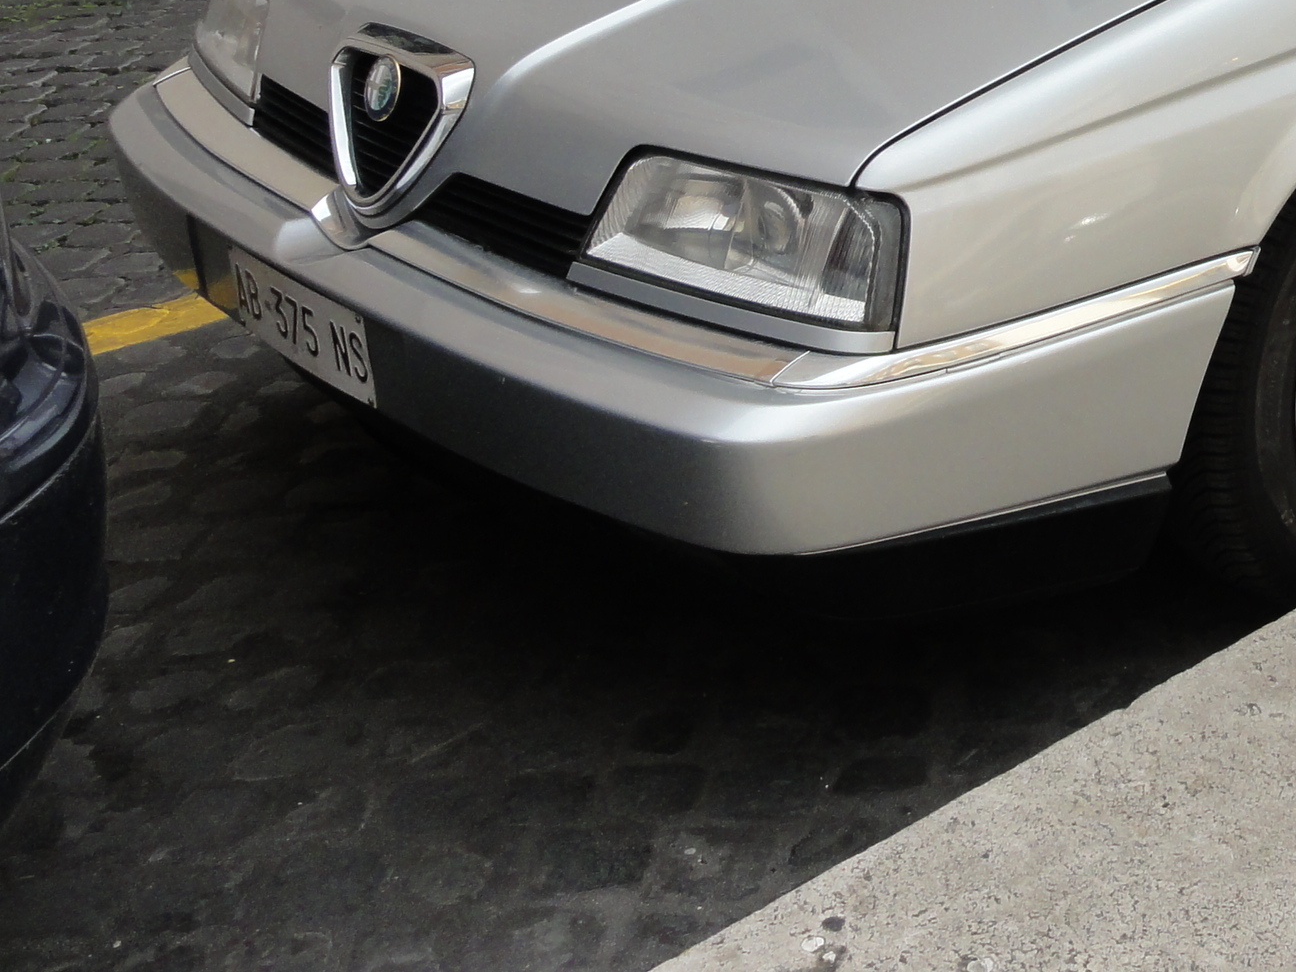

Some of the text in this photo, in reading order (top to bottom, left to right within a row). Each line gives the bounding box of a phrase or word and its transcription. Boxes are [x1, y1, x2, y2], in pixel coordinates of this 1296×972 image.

[235, 261, 369, 384] AB 375 NS
